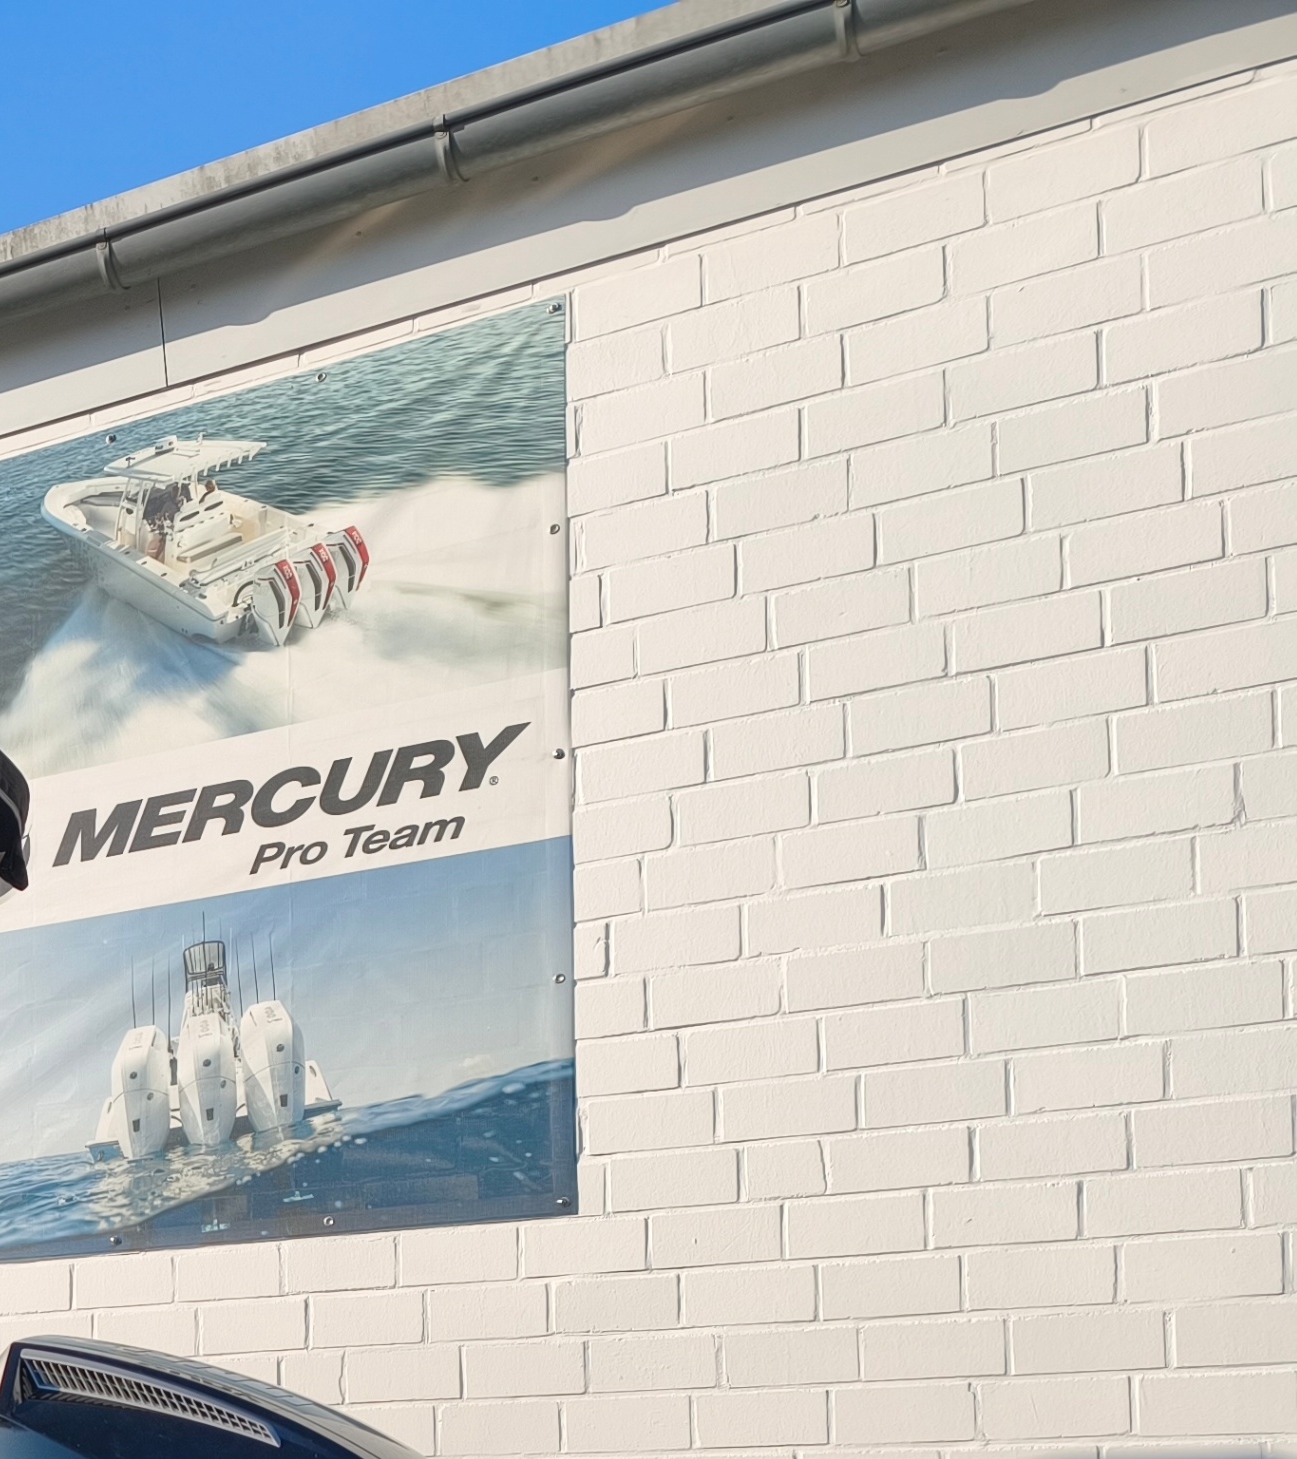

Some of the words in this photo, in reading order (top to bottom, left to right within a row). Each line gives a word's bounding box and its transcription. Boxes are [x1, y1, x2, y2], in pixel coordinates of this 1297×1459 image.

[52, 721, 532, 868] MERCURY
[249, 839, 328, 876] Pro
[343, 815, 466, 859] Team
